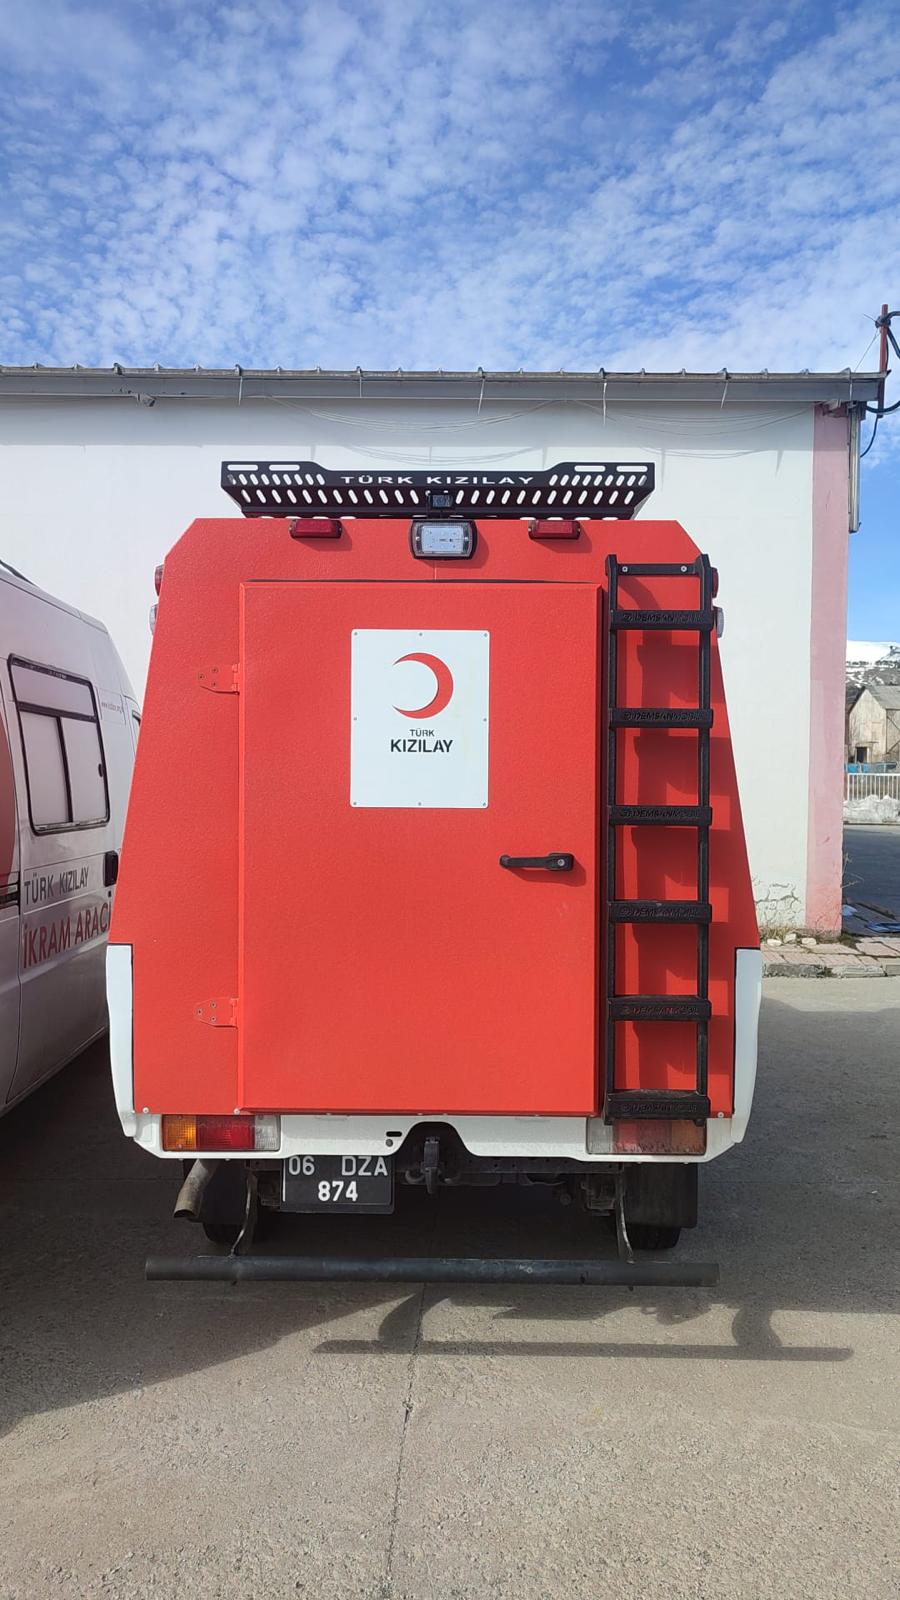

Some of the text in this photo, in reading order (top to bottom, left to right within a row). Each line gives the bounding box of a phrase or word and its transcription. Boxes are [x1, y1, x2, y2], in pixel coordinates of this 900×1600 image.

[340, 475, 534, 485] TÜRK KIZILAY
[409, 728, 435, 737] TÜRK
[390, 739, 453, 752] KIZILAY
[24, 866, 89, 905] TÜRK KIZILAY
[23, 923, 71, 969] İKRAM
[288, 1156, 388, 1176] 06 DZA
[318, 1180, 358, 1202] 874
